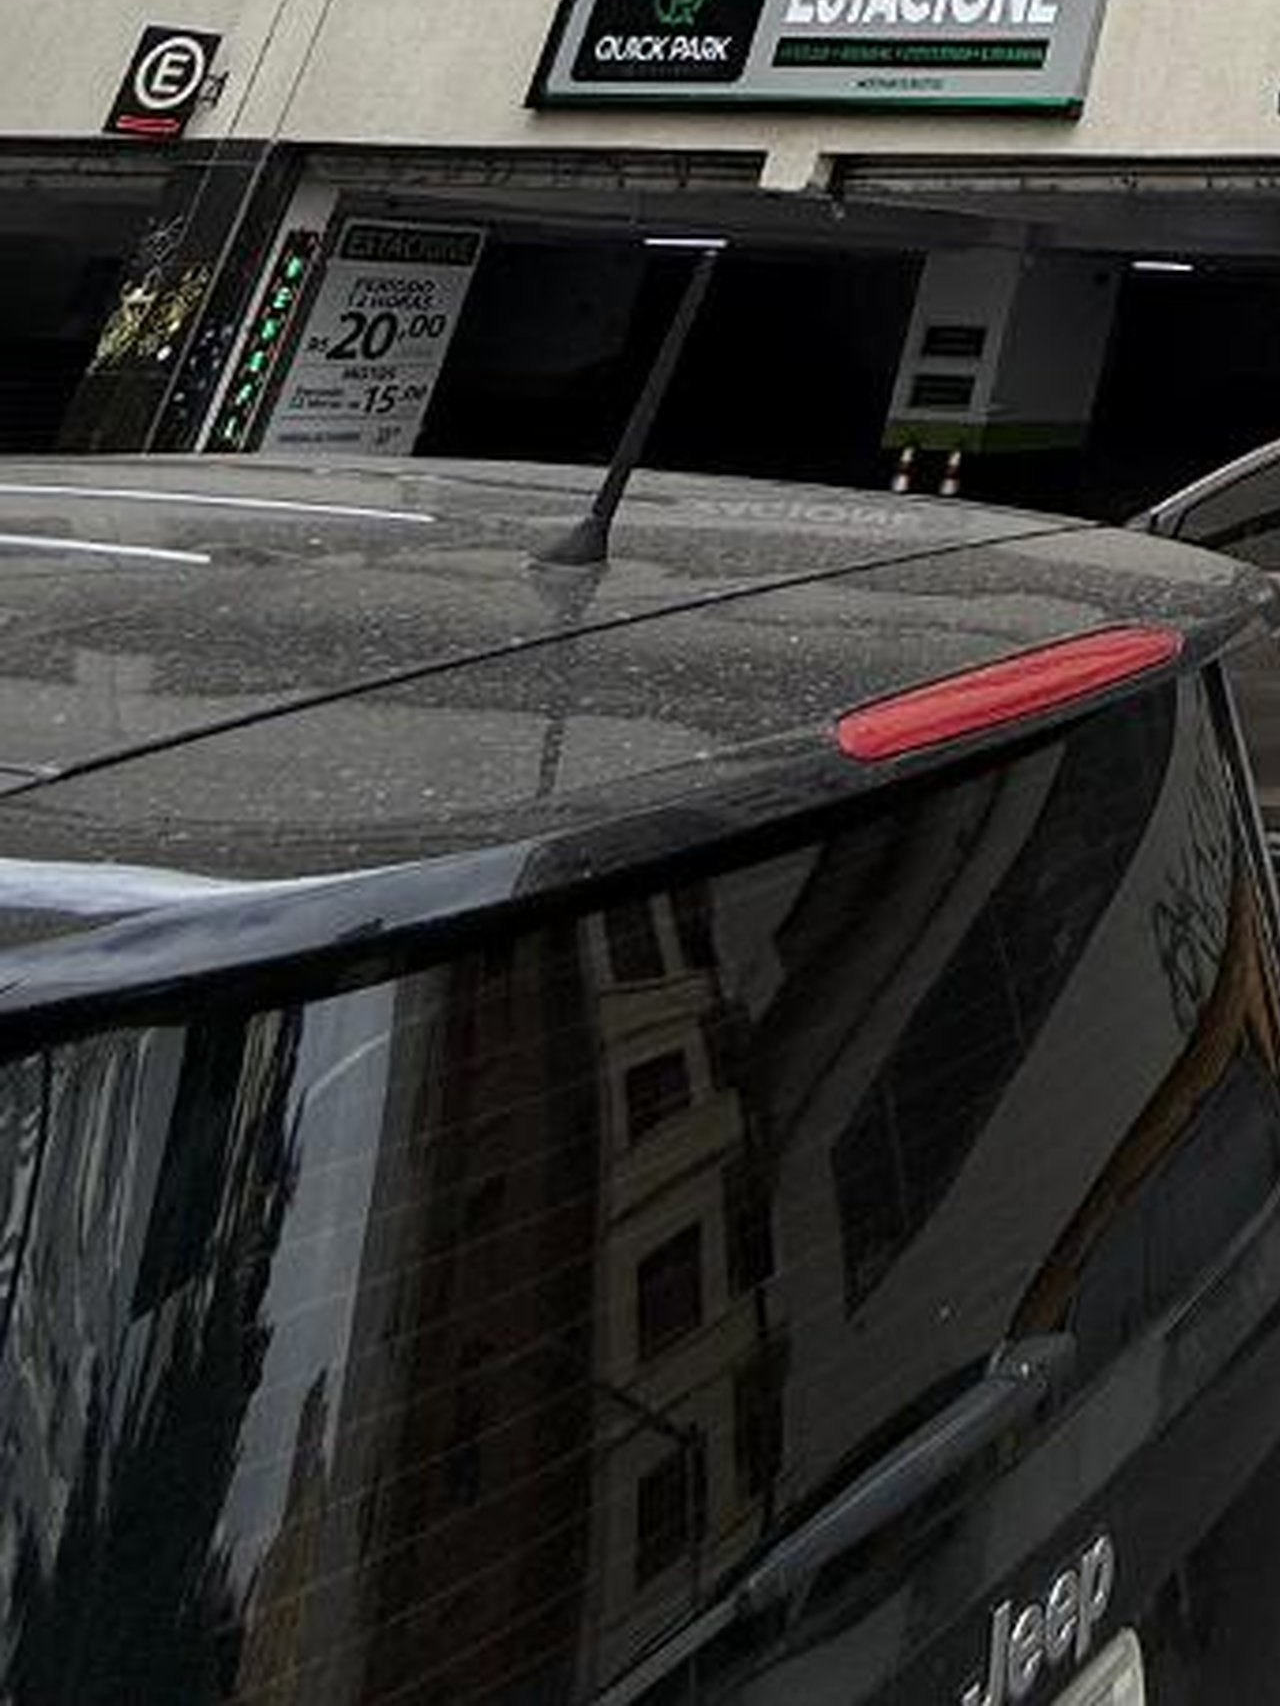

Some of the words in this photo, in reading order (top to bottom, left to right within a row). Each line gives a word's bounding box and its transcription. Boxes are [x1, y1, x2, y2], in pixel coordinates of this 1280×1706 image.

[594, 35, 670, 61] QUICK
[668, 35, 732, 61] PARK
[150, 51, 191, 93] E
[962, 1535, 1114, 1706] Jeep
